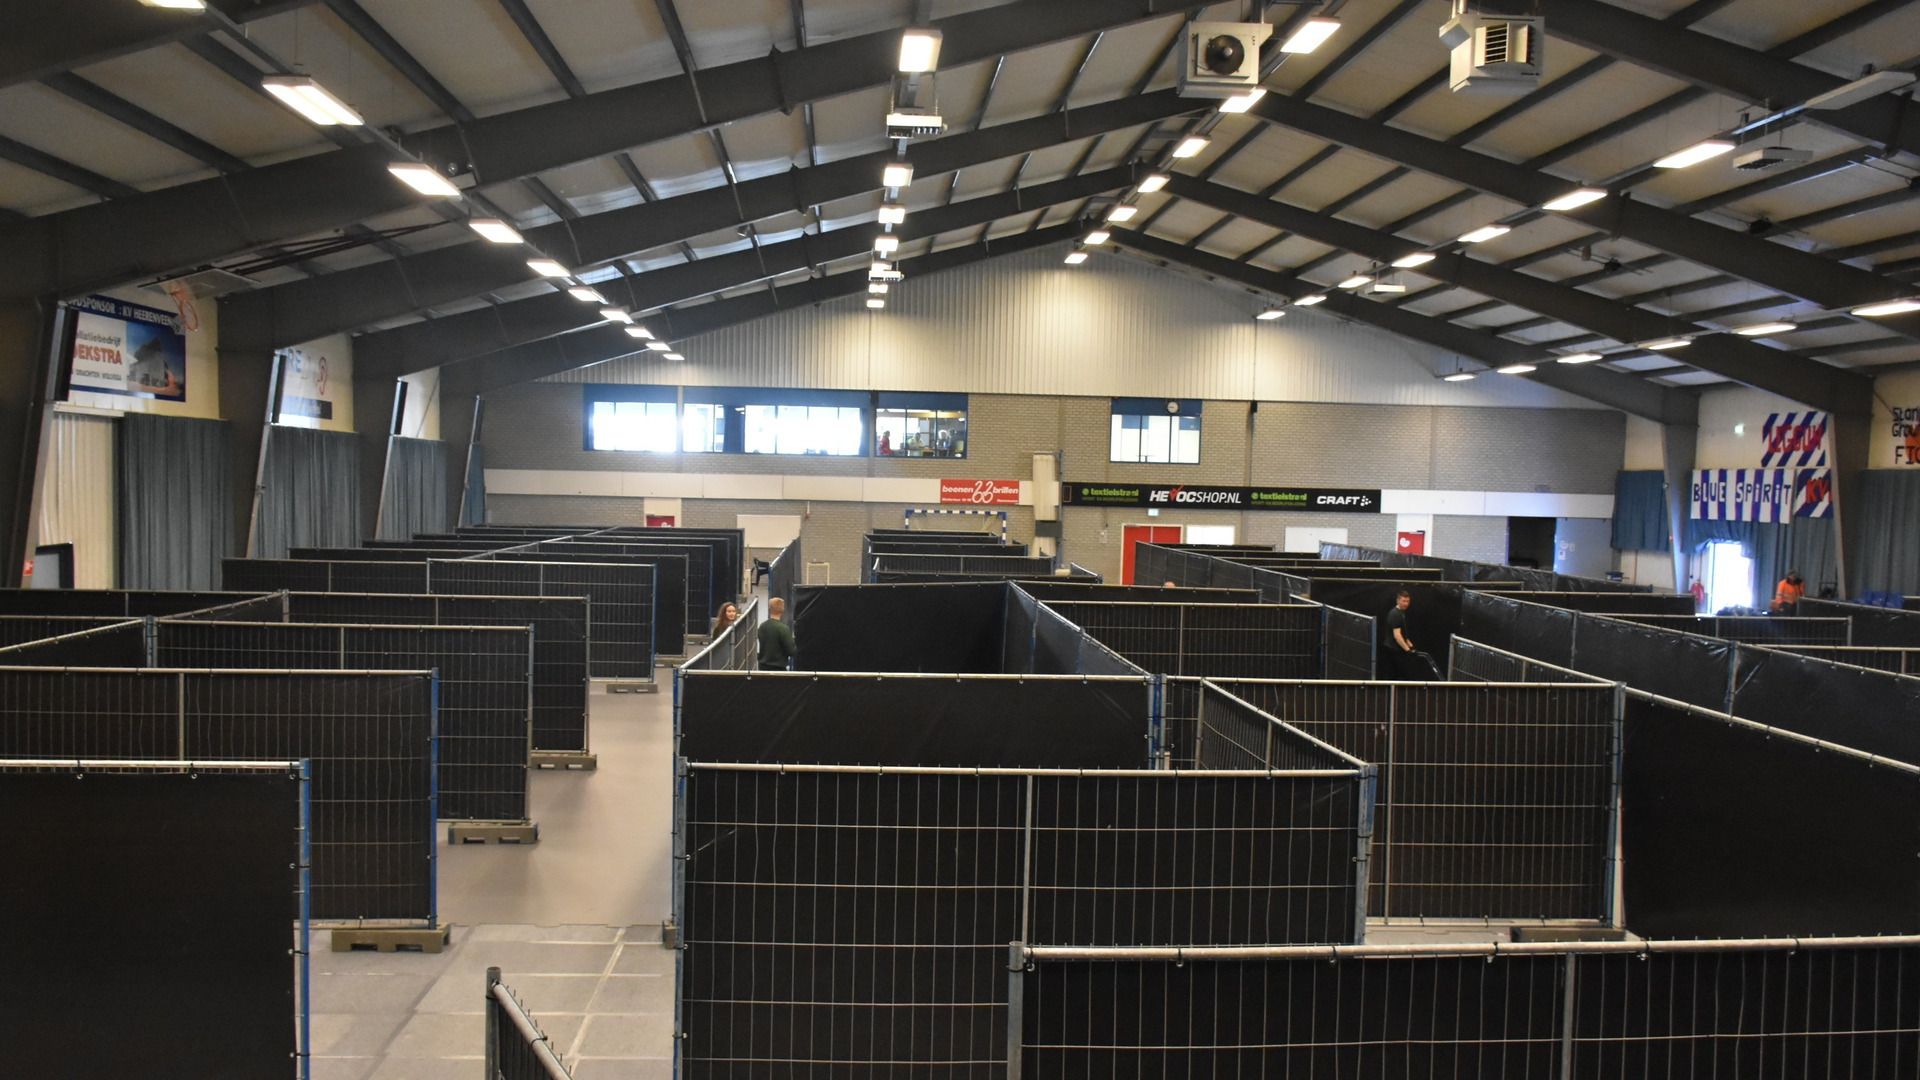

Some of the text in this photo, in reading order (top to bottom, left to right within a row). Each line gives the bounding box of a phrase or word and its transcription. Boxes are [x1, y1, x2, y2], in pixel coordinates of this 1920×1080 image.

[942, 485, 1019, 495] beenen brillen
[1693, 482, 1727, 503] BLUE
[1316, 495, 1360, 505] CRAFT
